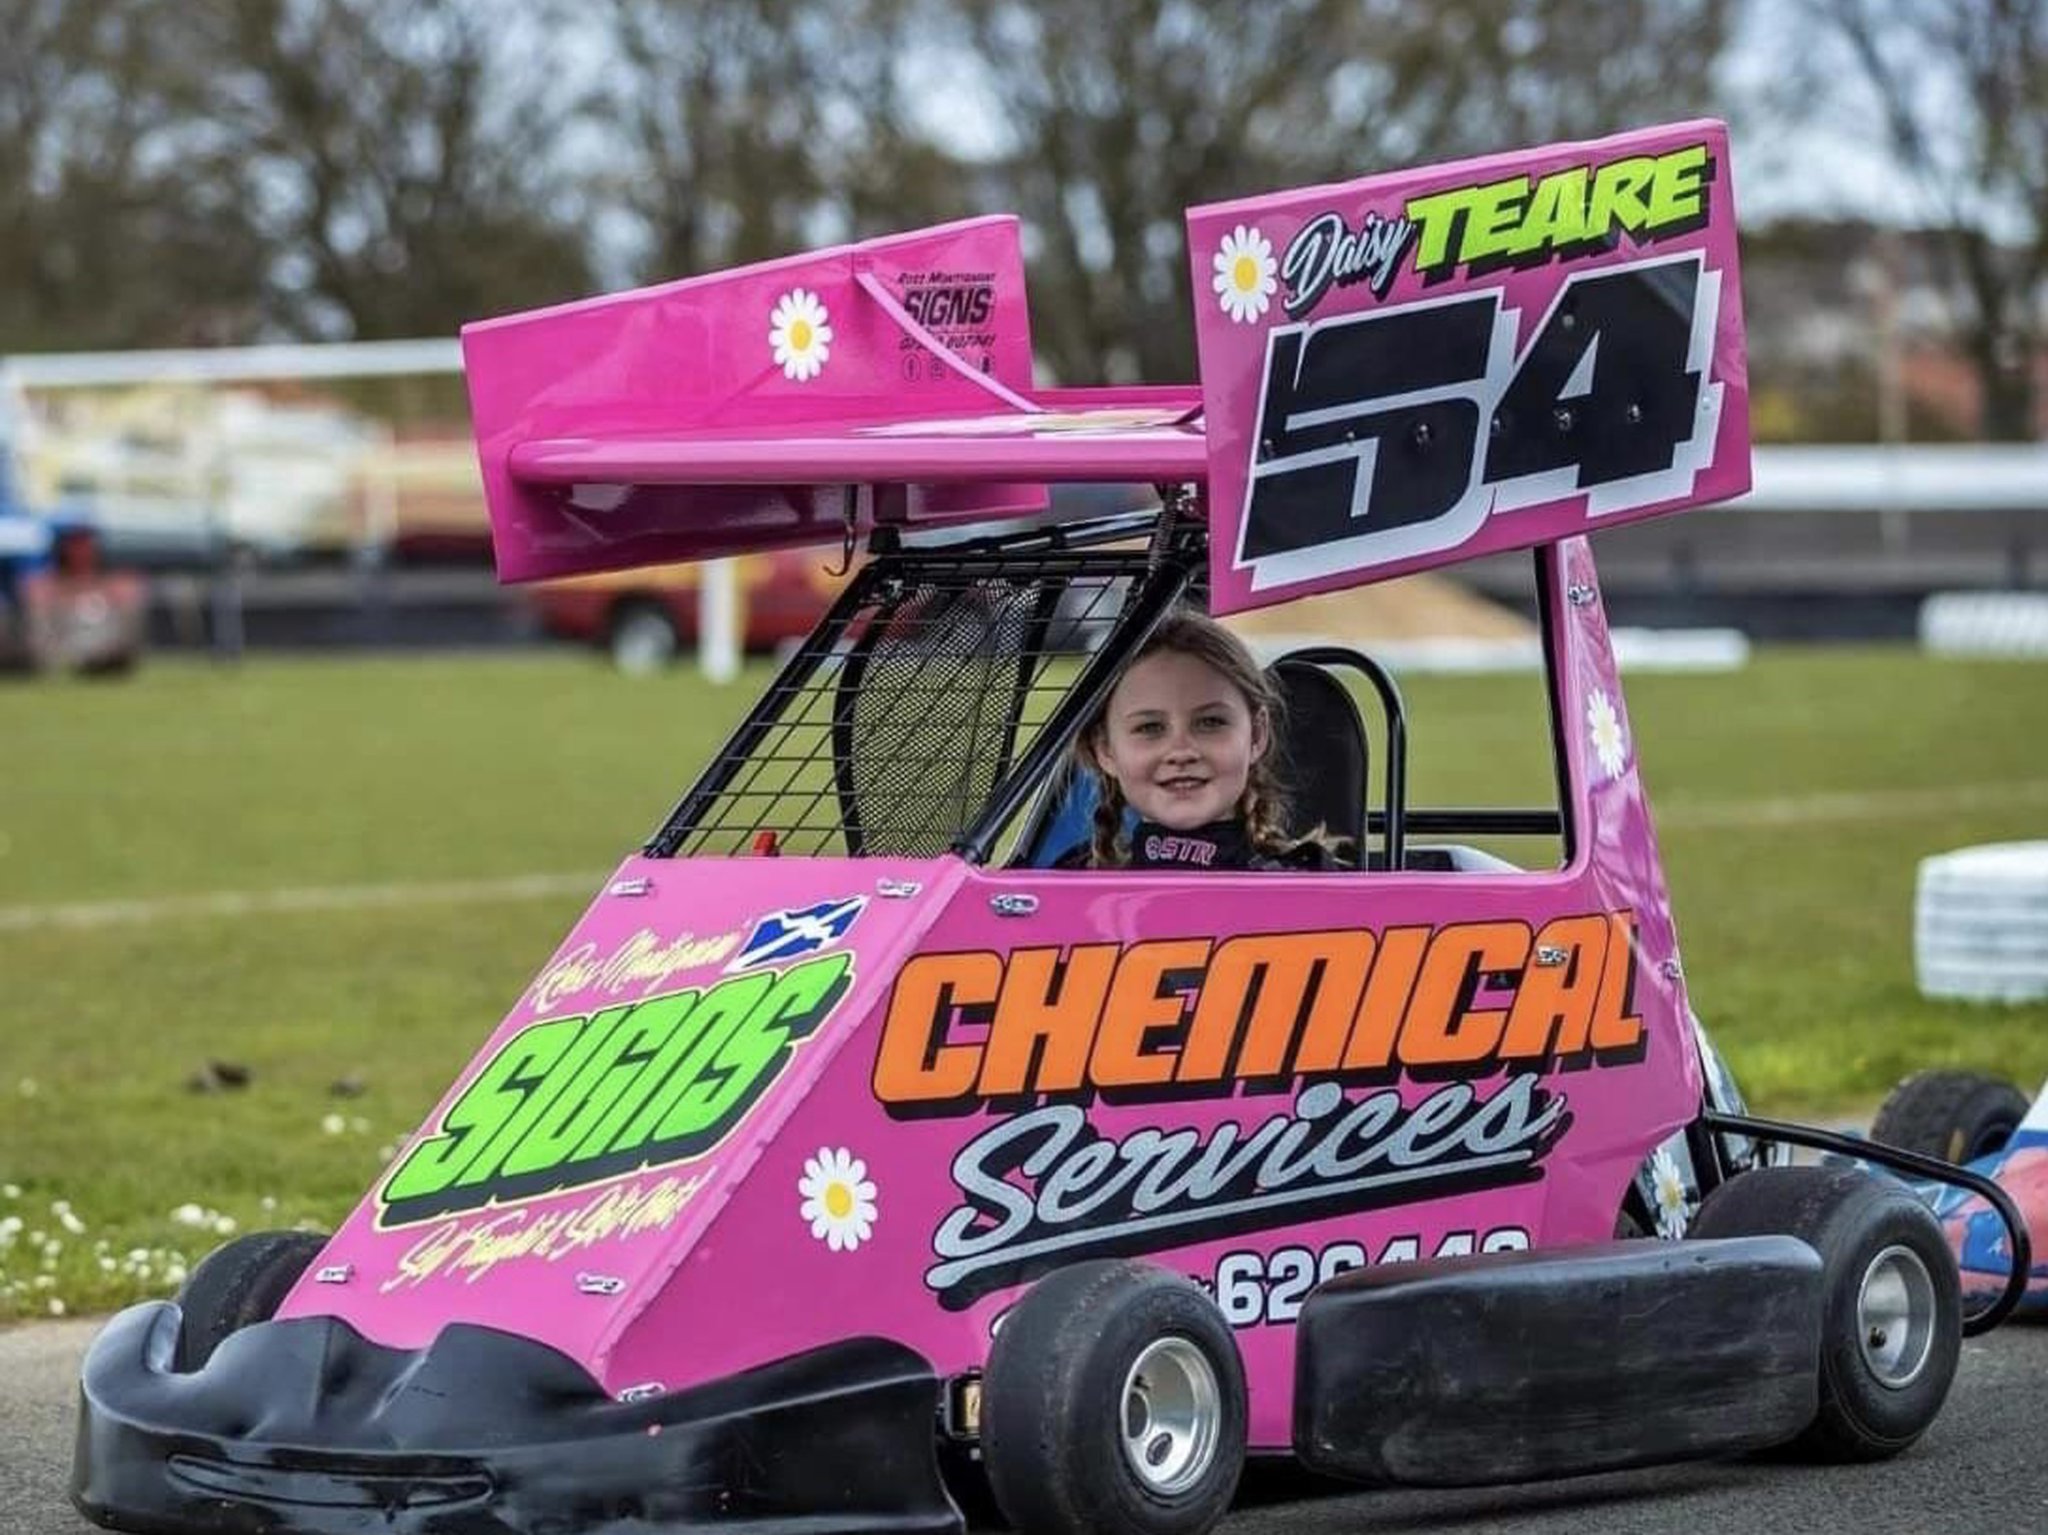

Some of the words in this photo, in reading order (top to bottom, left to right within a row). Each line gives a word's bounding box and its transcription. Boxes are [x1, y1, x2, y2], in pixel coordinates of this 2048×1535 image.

[903, 287, 991, 326] SIGNS
[1283, 211, 1416, 310] Daisy
[1403, 144, 1713, 284] TEARE
[1233, 249, 1719, 588] 54
[378, 952, 854, 1228] SIGNS
[871, 908, 1646, 1118] CHEMICAL
[932, 1071, 1568, 1262] Services
